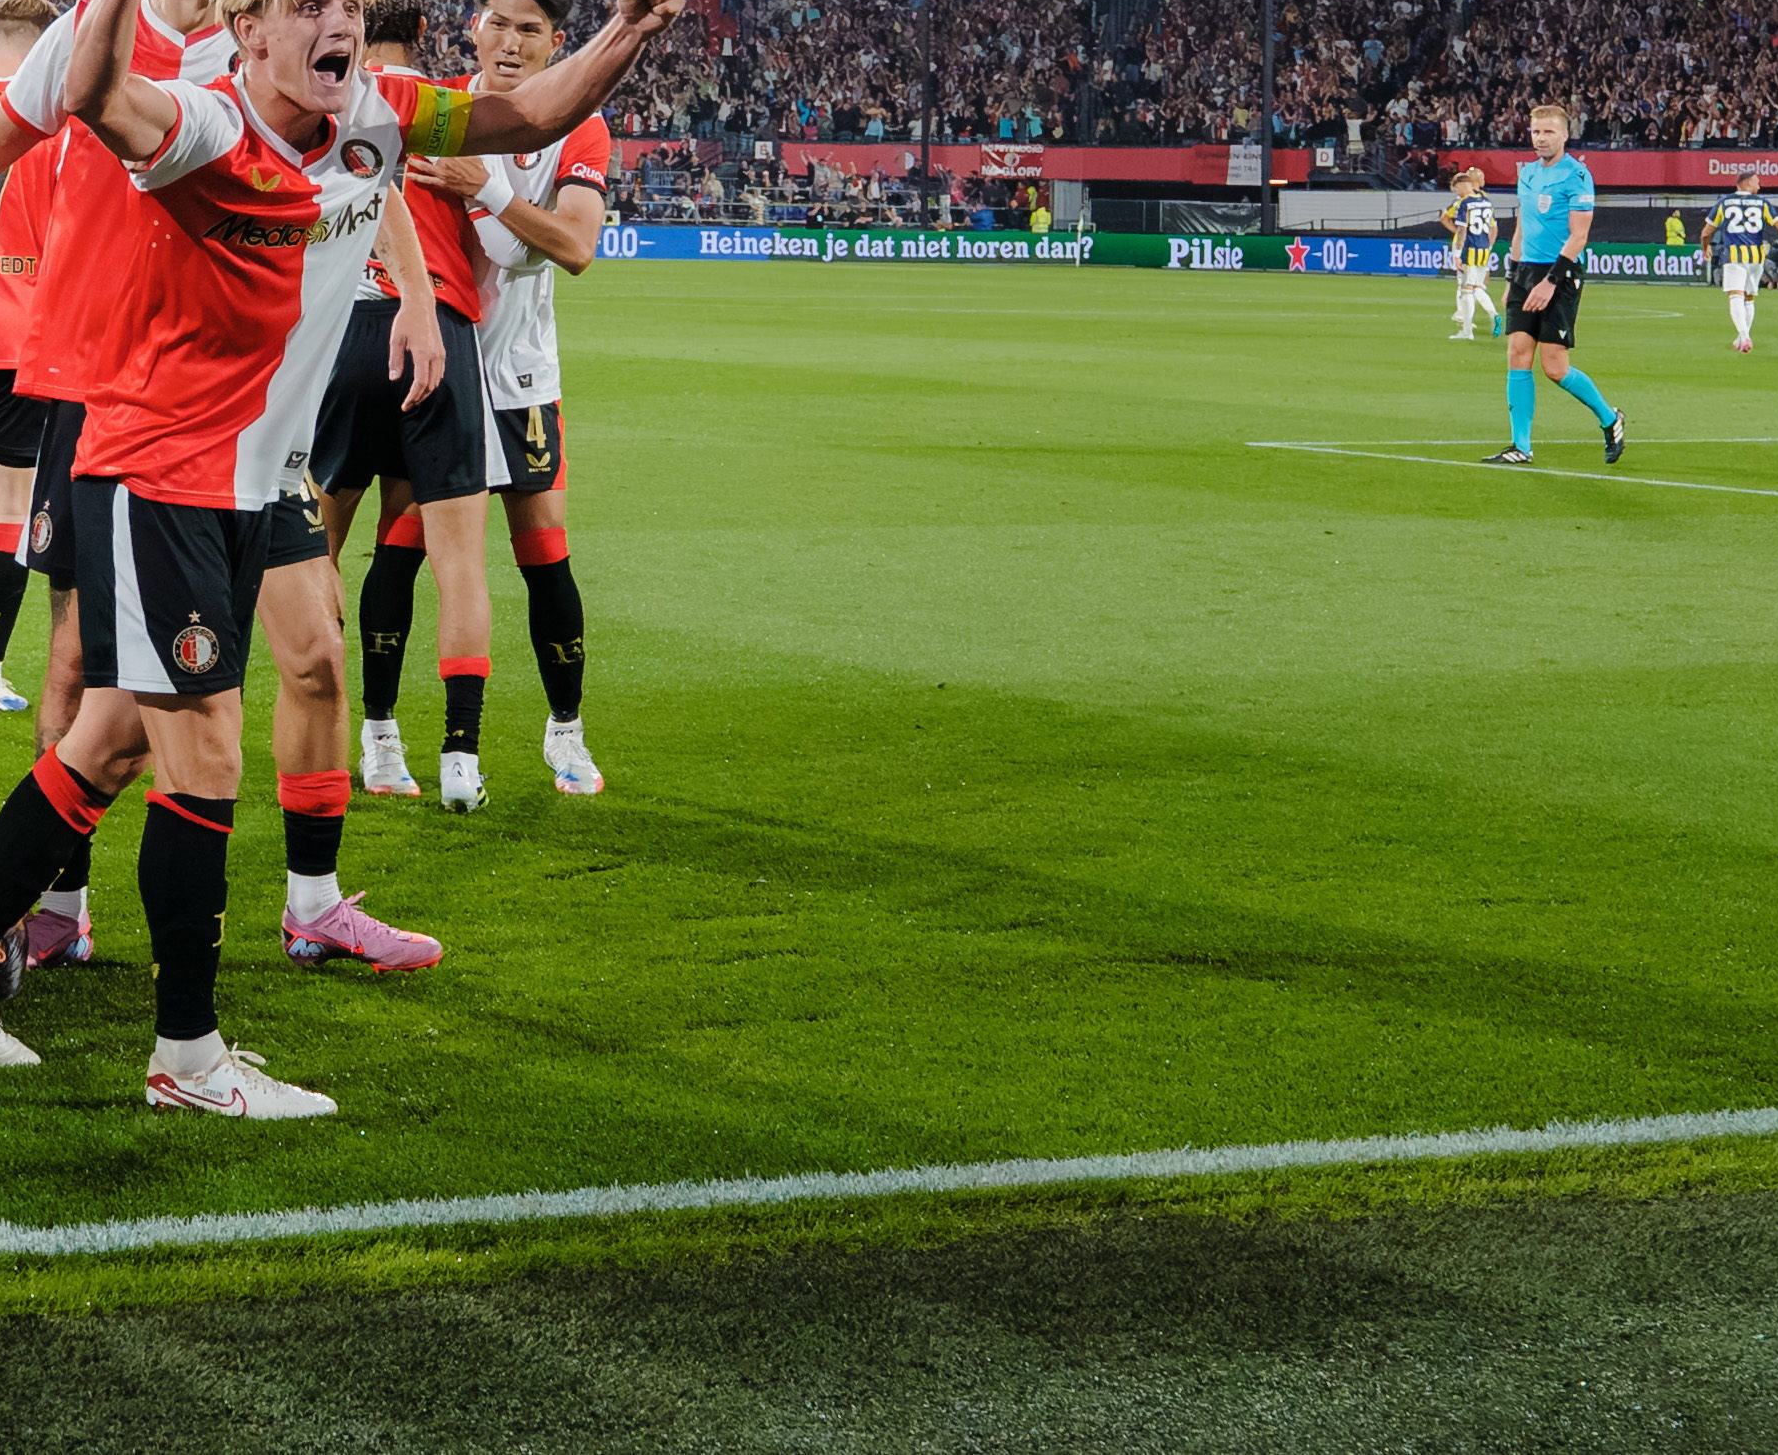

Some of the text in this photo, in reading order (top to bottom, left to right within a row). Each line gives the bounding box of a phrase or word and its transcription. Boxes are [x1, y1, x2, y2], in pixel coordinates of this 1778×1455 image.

[1321, 151, 1330, 164] D
[1469, 208, 1493, 235] 53
[1724, 205, 1764, 234] 23
[699, 229, 1093, 263] Heineken je dat niet horen dan?
[1390, 243, 1457, 270] Heinek
[1586, 248, 1649, 275] horen
[1653, 249, 1704, 276] dan?
